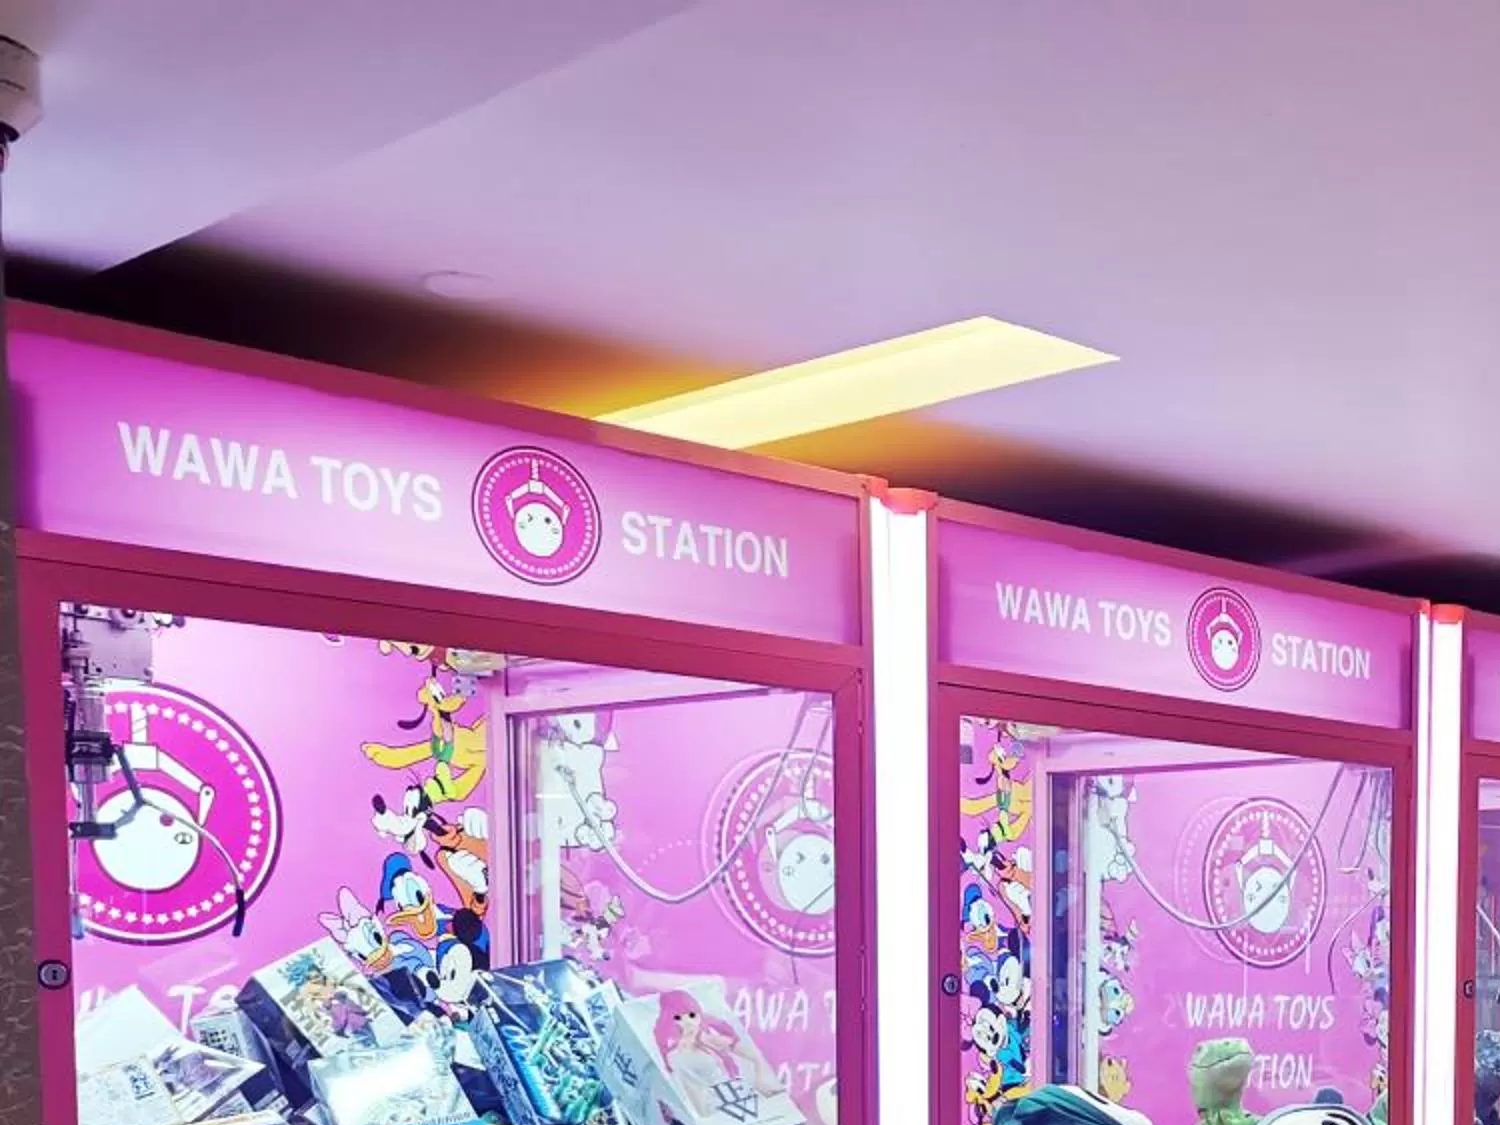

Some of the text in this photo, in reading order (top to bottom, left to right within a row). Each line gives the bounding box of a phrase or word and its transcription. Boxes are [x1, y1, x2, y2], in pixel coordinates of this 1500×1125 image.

[117, 421, 790, 578] WAWA TOYS STATION
[995, 581, 1370, 680] WAWA TOYS STATION
[734, 987, 809, 1032] AWA
[1185, 992, 1336, 1031] WAWA TOYS
[1247, 1053, 1313, 1090] TION
